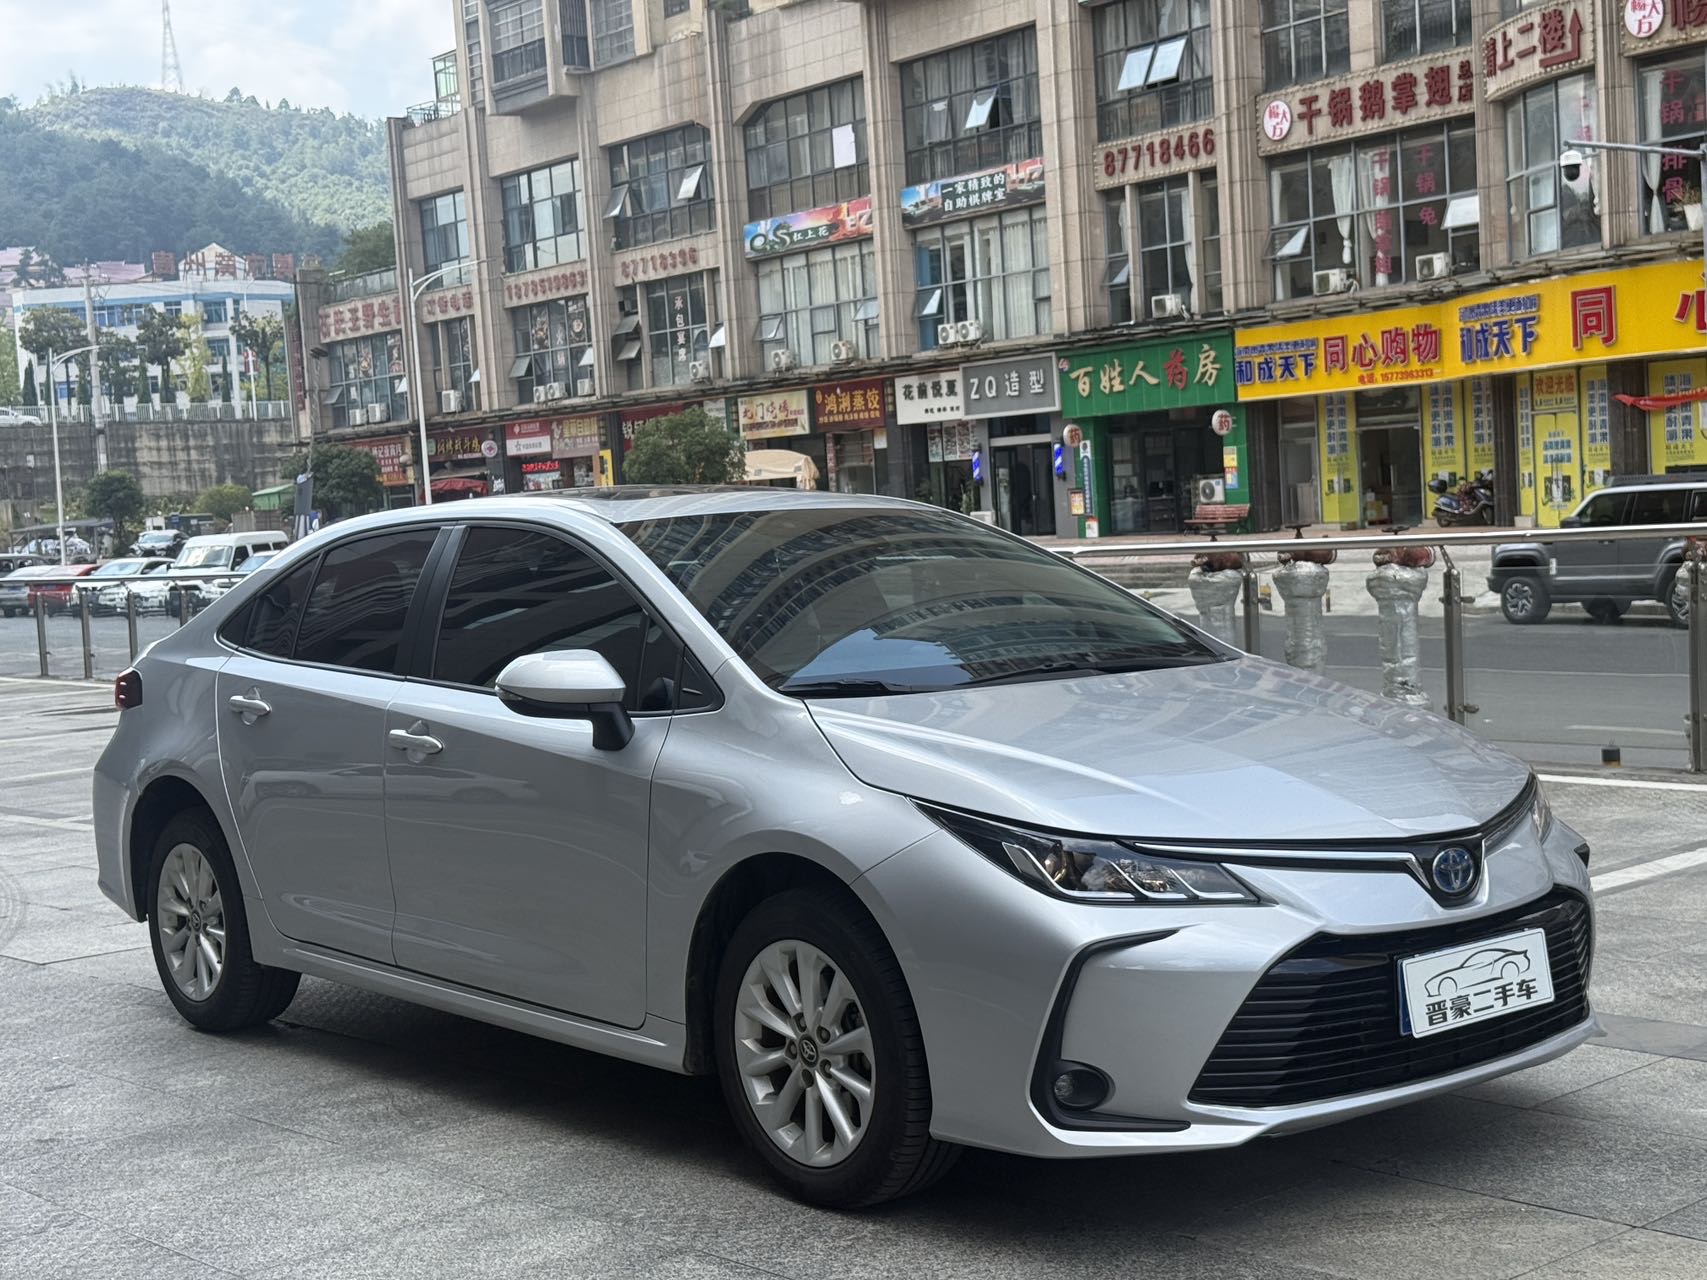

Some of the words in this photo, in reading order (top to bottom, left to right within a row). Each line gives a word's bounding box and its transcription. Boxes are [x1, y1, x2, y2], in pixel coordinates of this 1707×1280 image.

[1297, 65, 1452, 135] 干锅鹅掌翅
[1104, 128, 1215, 177] 87718466
[942, 173, 1005, 195] 一家精致的
[944, 187, 1007, 212] 自助棋牌室
[673, 295, 688, 363] 承包宴席
[1323, 324, 1441, 373] 同心购物
[1461, 315, 1538, 363] 和成天下
[1069, 344, 1222, 398] 百姓人药房
[1236, 352, 1316, 385] 和成天下
[1536, 373, 1575, 396] 欢迎光临
[1218, 413, 1232, 432] 药
[1426, 978, 1538, 1026] 晋豪二手车
